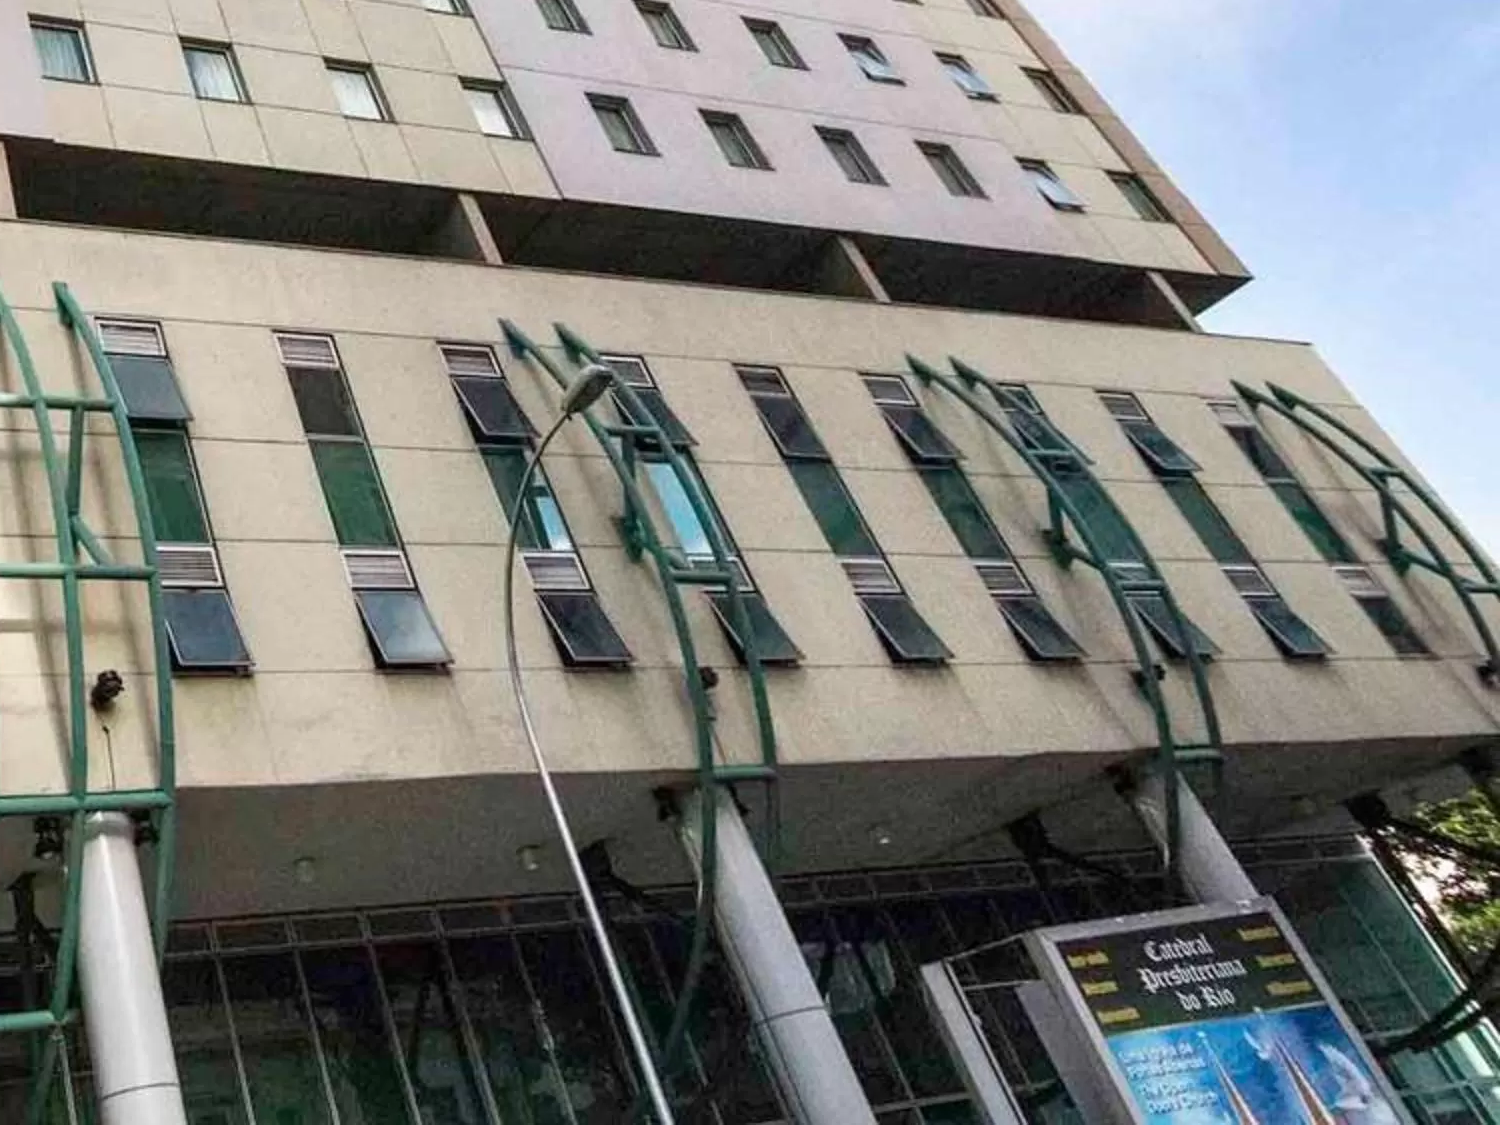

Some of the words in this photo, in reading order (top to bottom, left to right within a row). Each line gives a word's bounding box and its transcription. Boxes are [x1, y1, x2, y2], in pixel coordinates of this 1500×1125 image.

[1144, 933, 1214, 961] Catedral
[1136, 959, 1247, 994] Presbiteriana
[1200, 986, 1236, 1008] Rio
